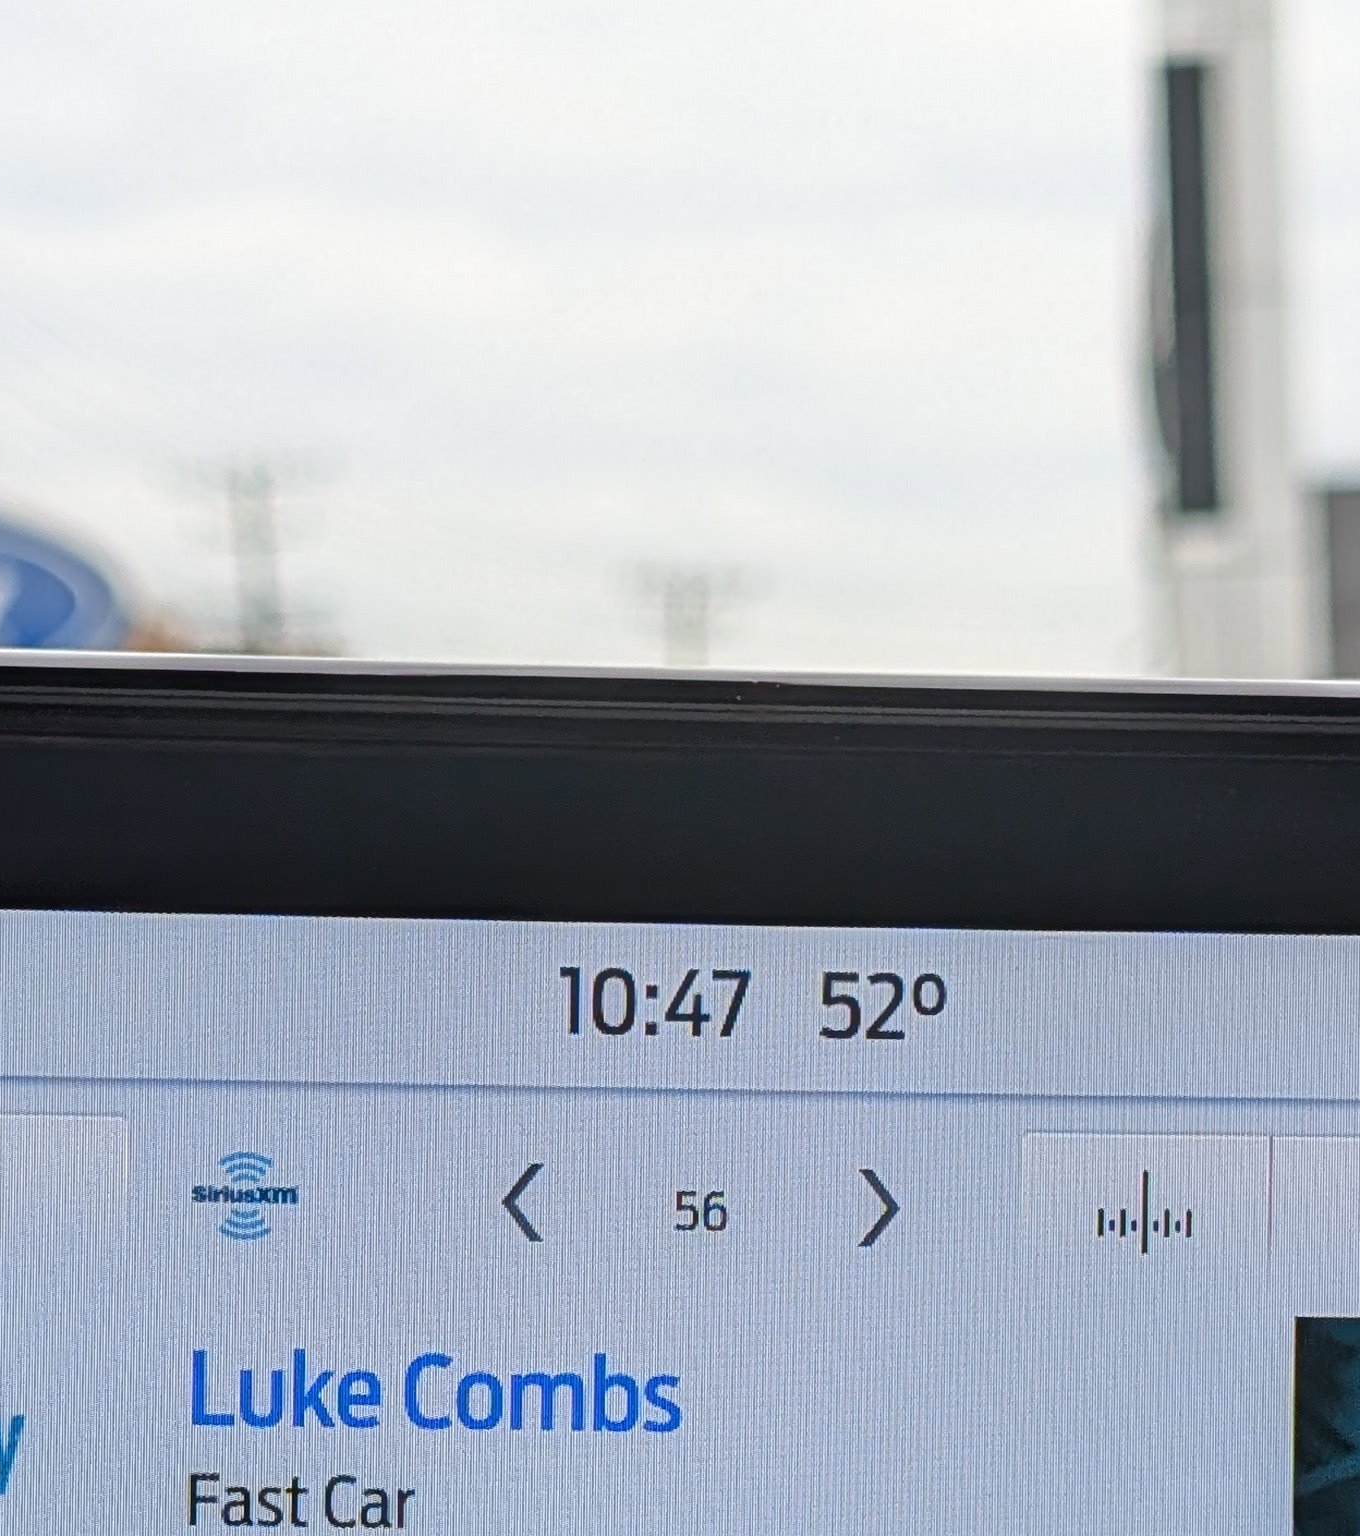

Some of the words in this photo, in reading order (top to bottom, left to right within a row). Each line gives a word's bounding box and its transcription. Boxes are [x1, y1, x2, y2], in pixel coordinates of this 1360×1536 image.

[560, 966, 751, 1037] 10:47
[675, 1190, 728, 1232] 56
[192, 1349, 382, 1429] Luke
[404, 1352, 682, 1433] Combs
[189, 1473, 308, 1528] Fast
[324, 1474, 416, 1529] Car
